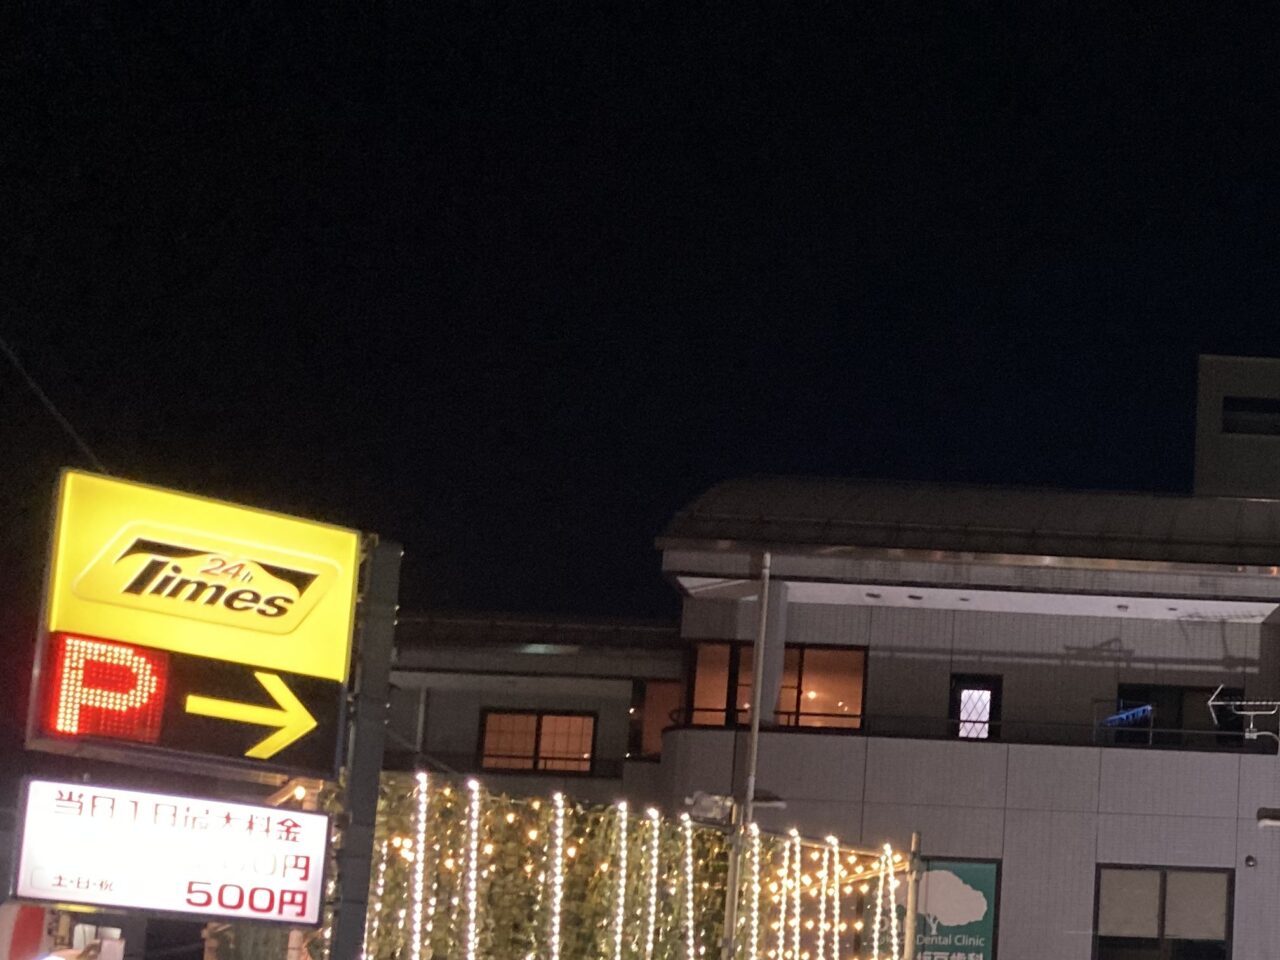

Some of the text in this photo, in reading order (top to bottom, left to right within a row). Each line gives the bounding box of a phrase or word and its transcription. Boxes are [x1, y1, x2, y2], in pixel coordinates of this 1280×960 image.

[114, 538, 295, 618] Times
[56, 637, 157, 733] P
[185, 880, 309, 918] 500円
[917, 934, 951, 945] Dental
[954, 934, 985, 947] Clinic
